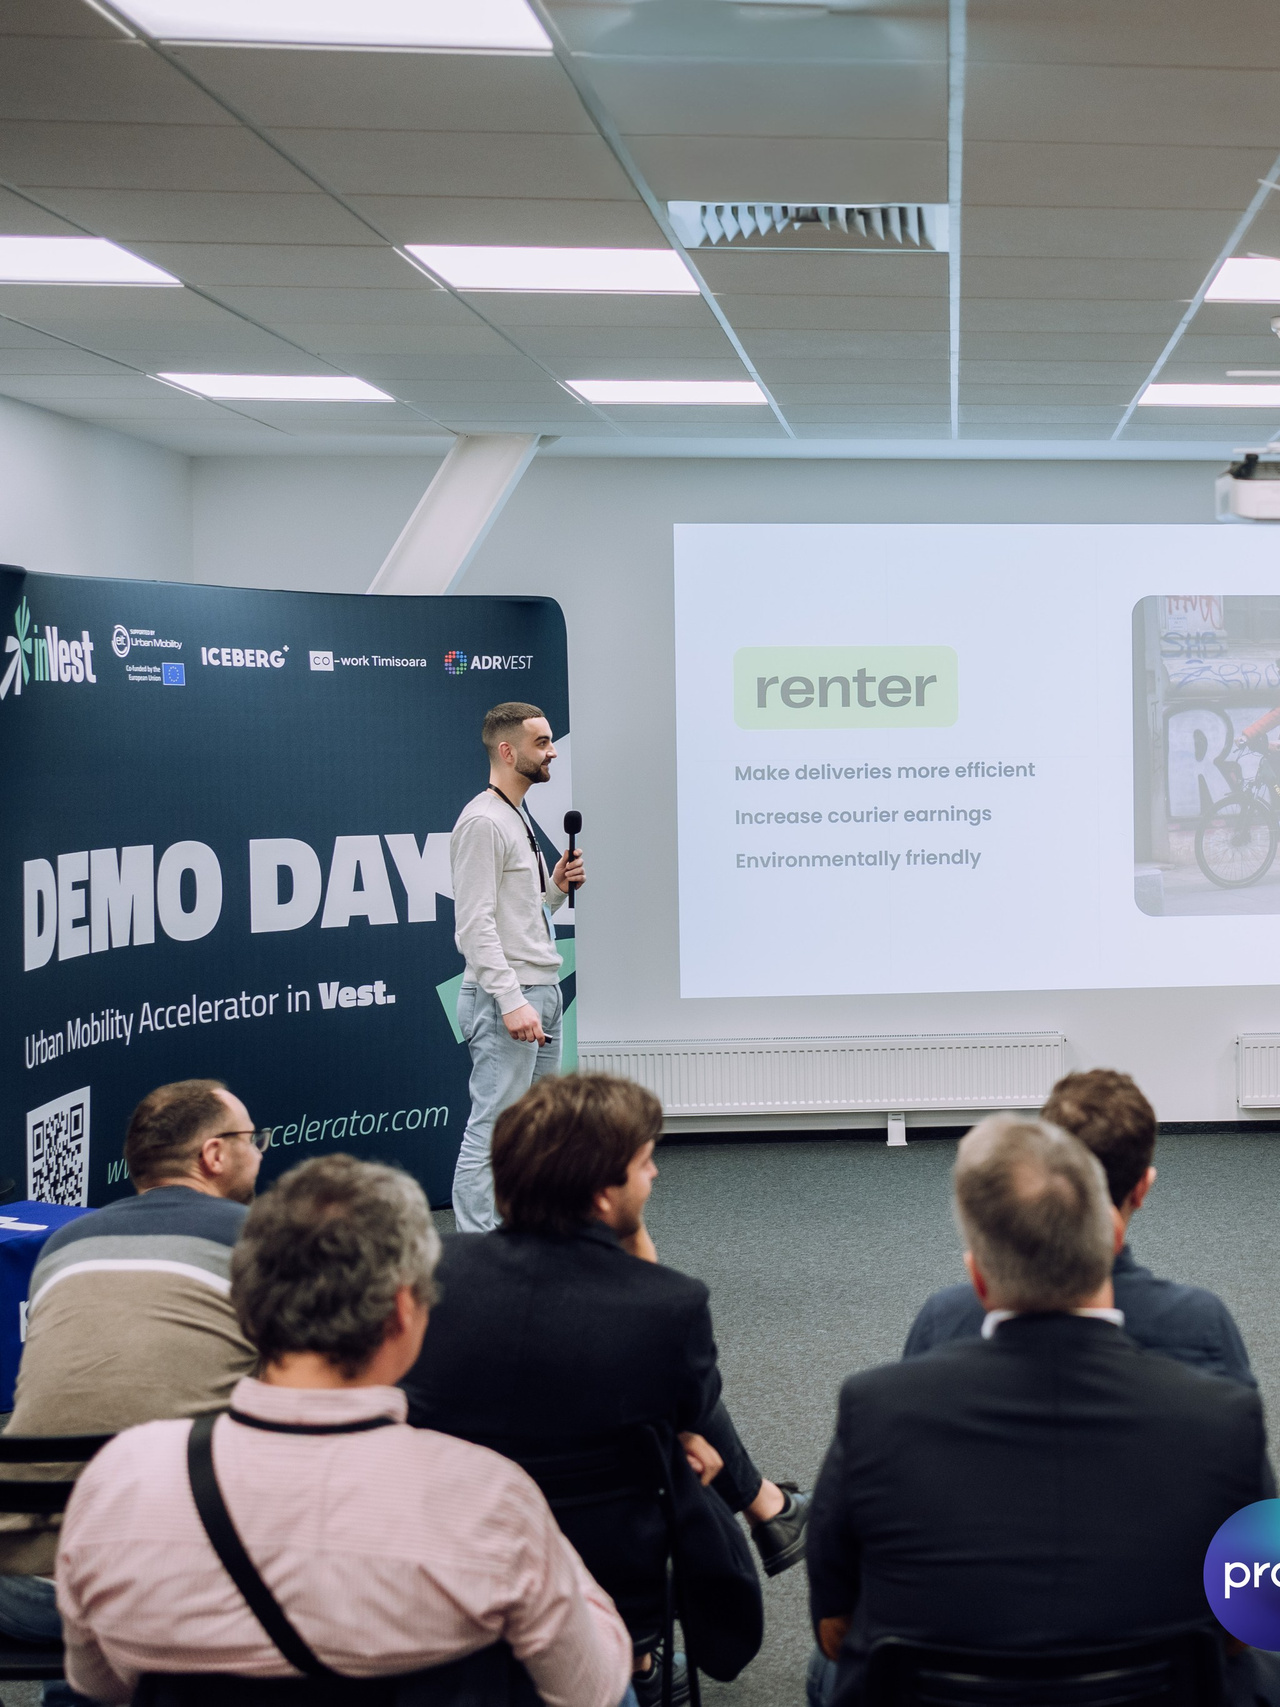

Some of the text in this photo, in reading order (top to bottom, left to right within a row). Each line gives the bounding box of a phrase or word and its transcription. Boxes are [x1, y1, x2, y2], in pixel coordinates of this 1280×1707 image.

[33, 624, 97, 684] inVest
[131, 637, 154, 647] Urban
[154, 638, 182, 650] Mobility
[373, 655, 427, 668] Timisoara
[470, 655, 534, 670] ADRVEST
[128, 674, 161, 682] European Union
[756, 667, 937, 709] renter
[734, 761, 1036, 781] Make deliveries more efficient
[735, 805, 992, 826] Increase courier earnings
[736, 848, 982, 871] Environmentally friendly
[23, 831, 456, 972] DEMO DAY
[25, 980, 396, 1069] Urban Mobility Accelerator in Vest.
